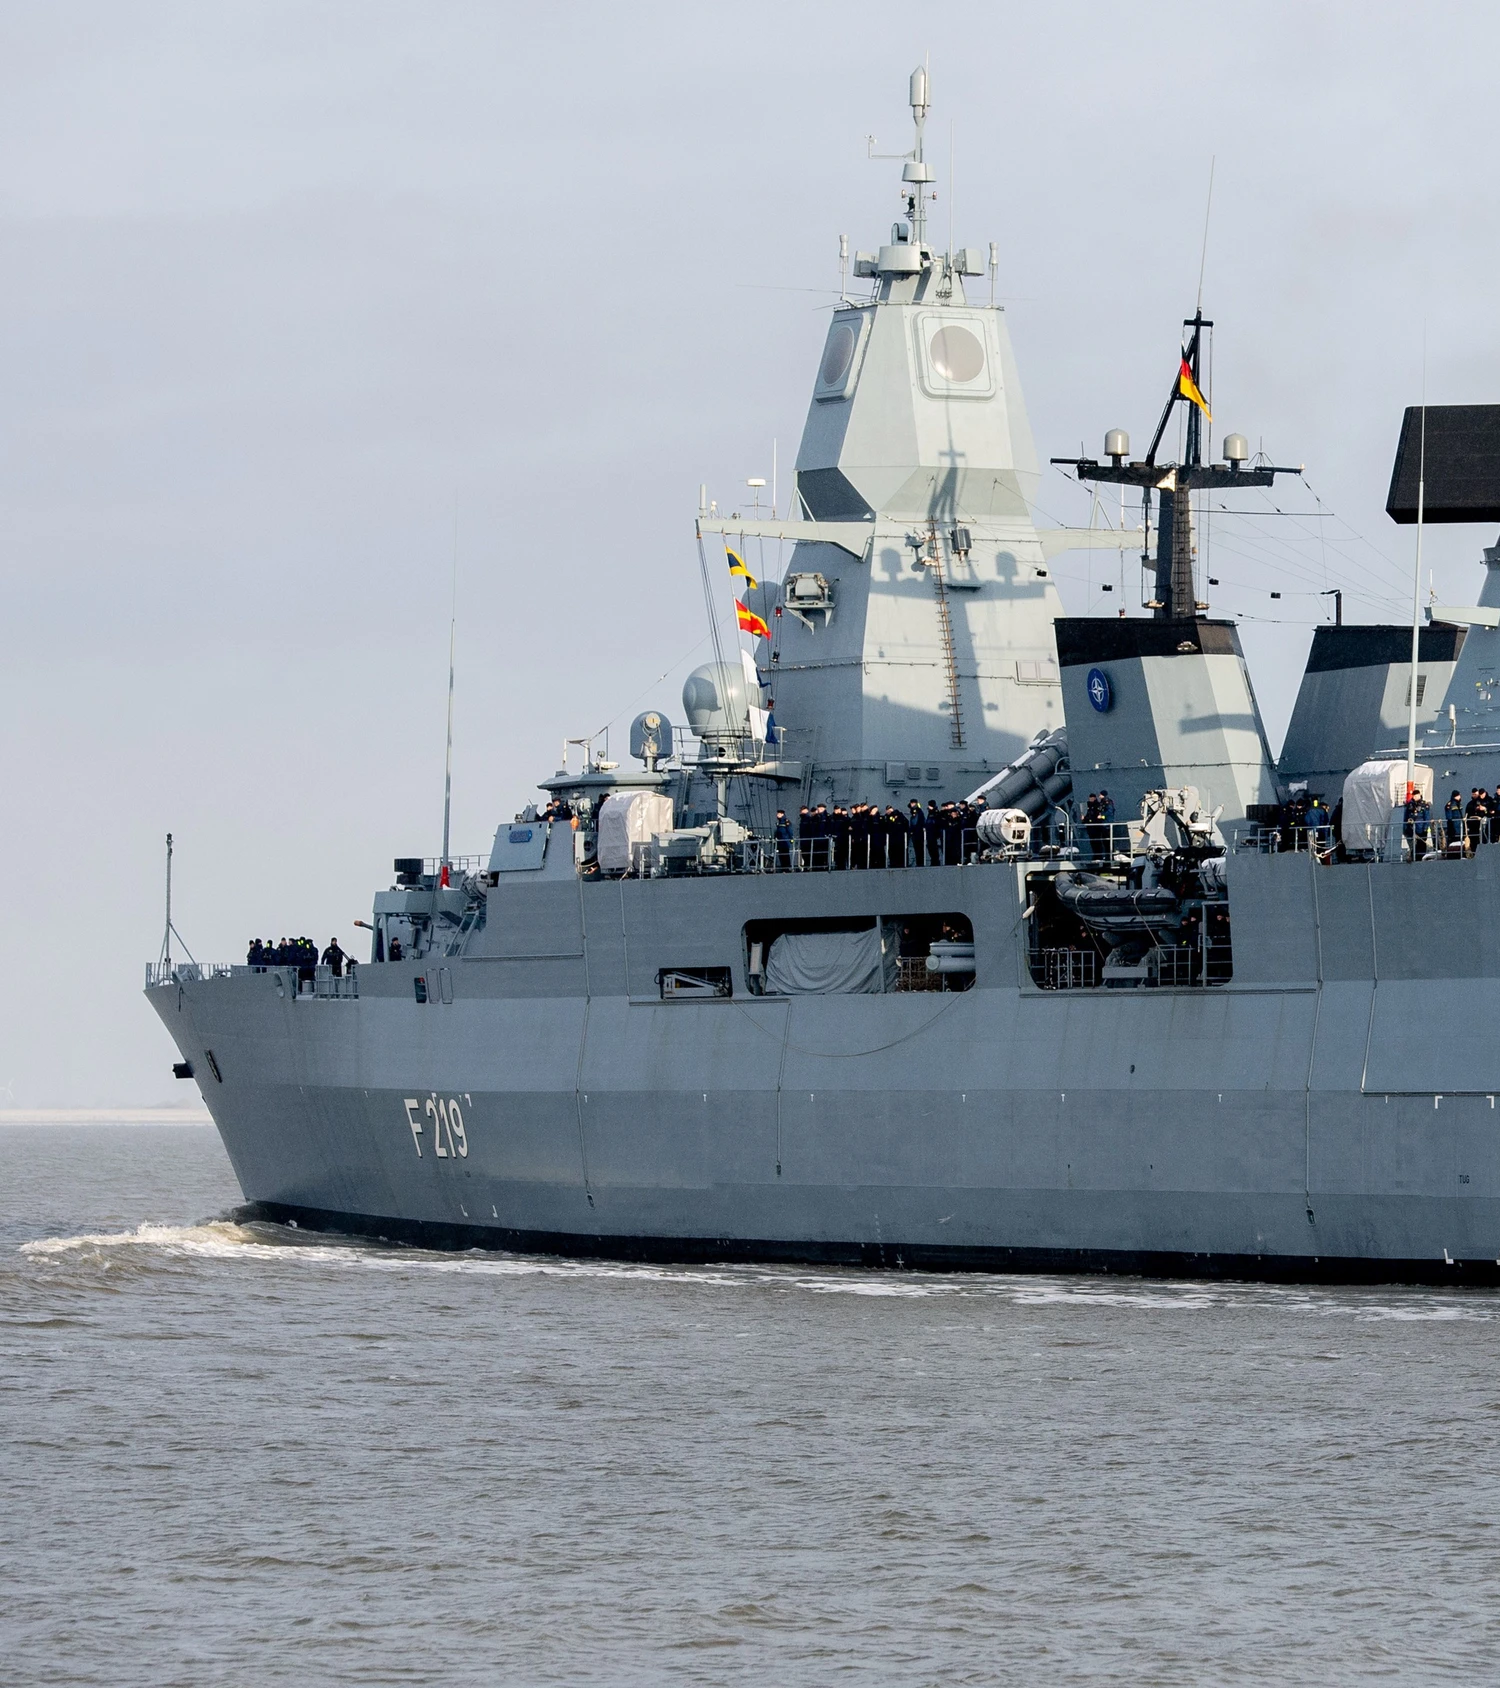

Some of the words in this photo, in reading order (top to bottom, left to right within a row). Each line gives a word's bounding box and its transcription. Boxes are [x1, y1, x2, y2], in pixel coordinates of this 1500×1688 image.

[404, 1098, 423, 1158] F
[425, 1098, 469, 1159] 219
[1459, 1174, 1470, 1184] TUG
